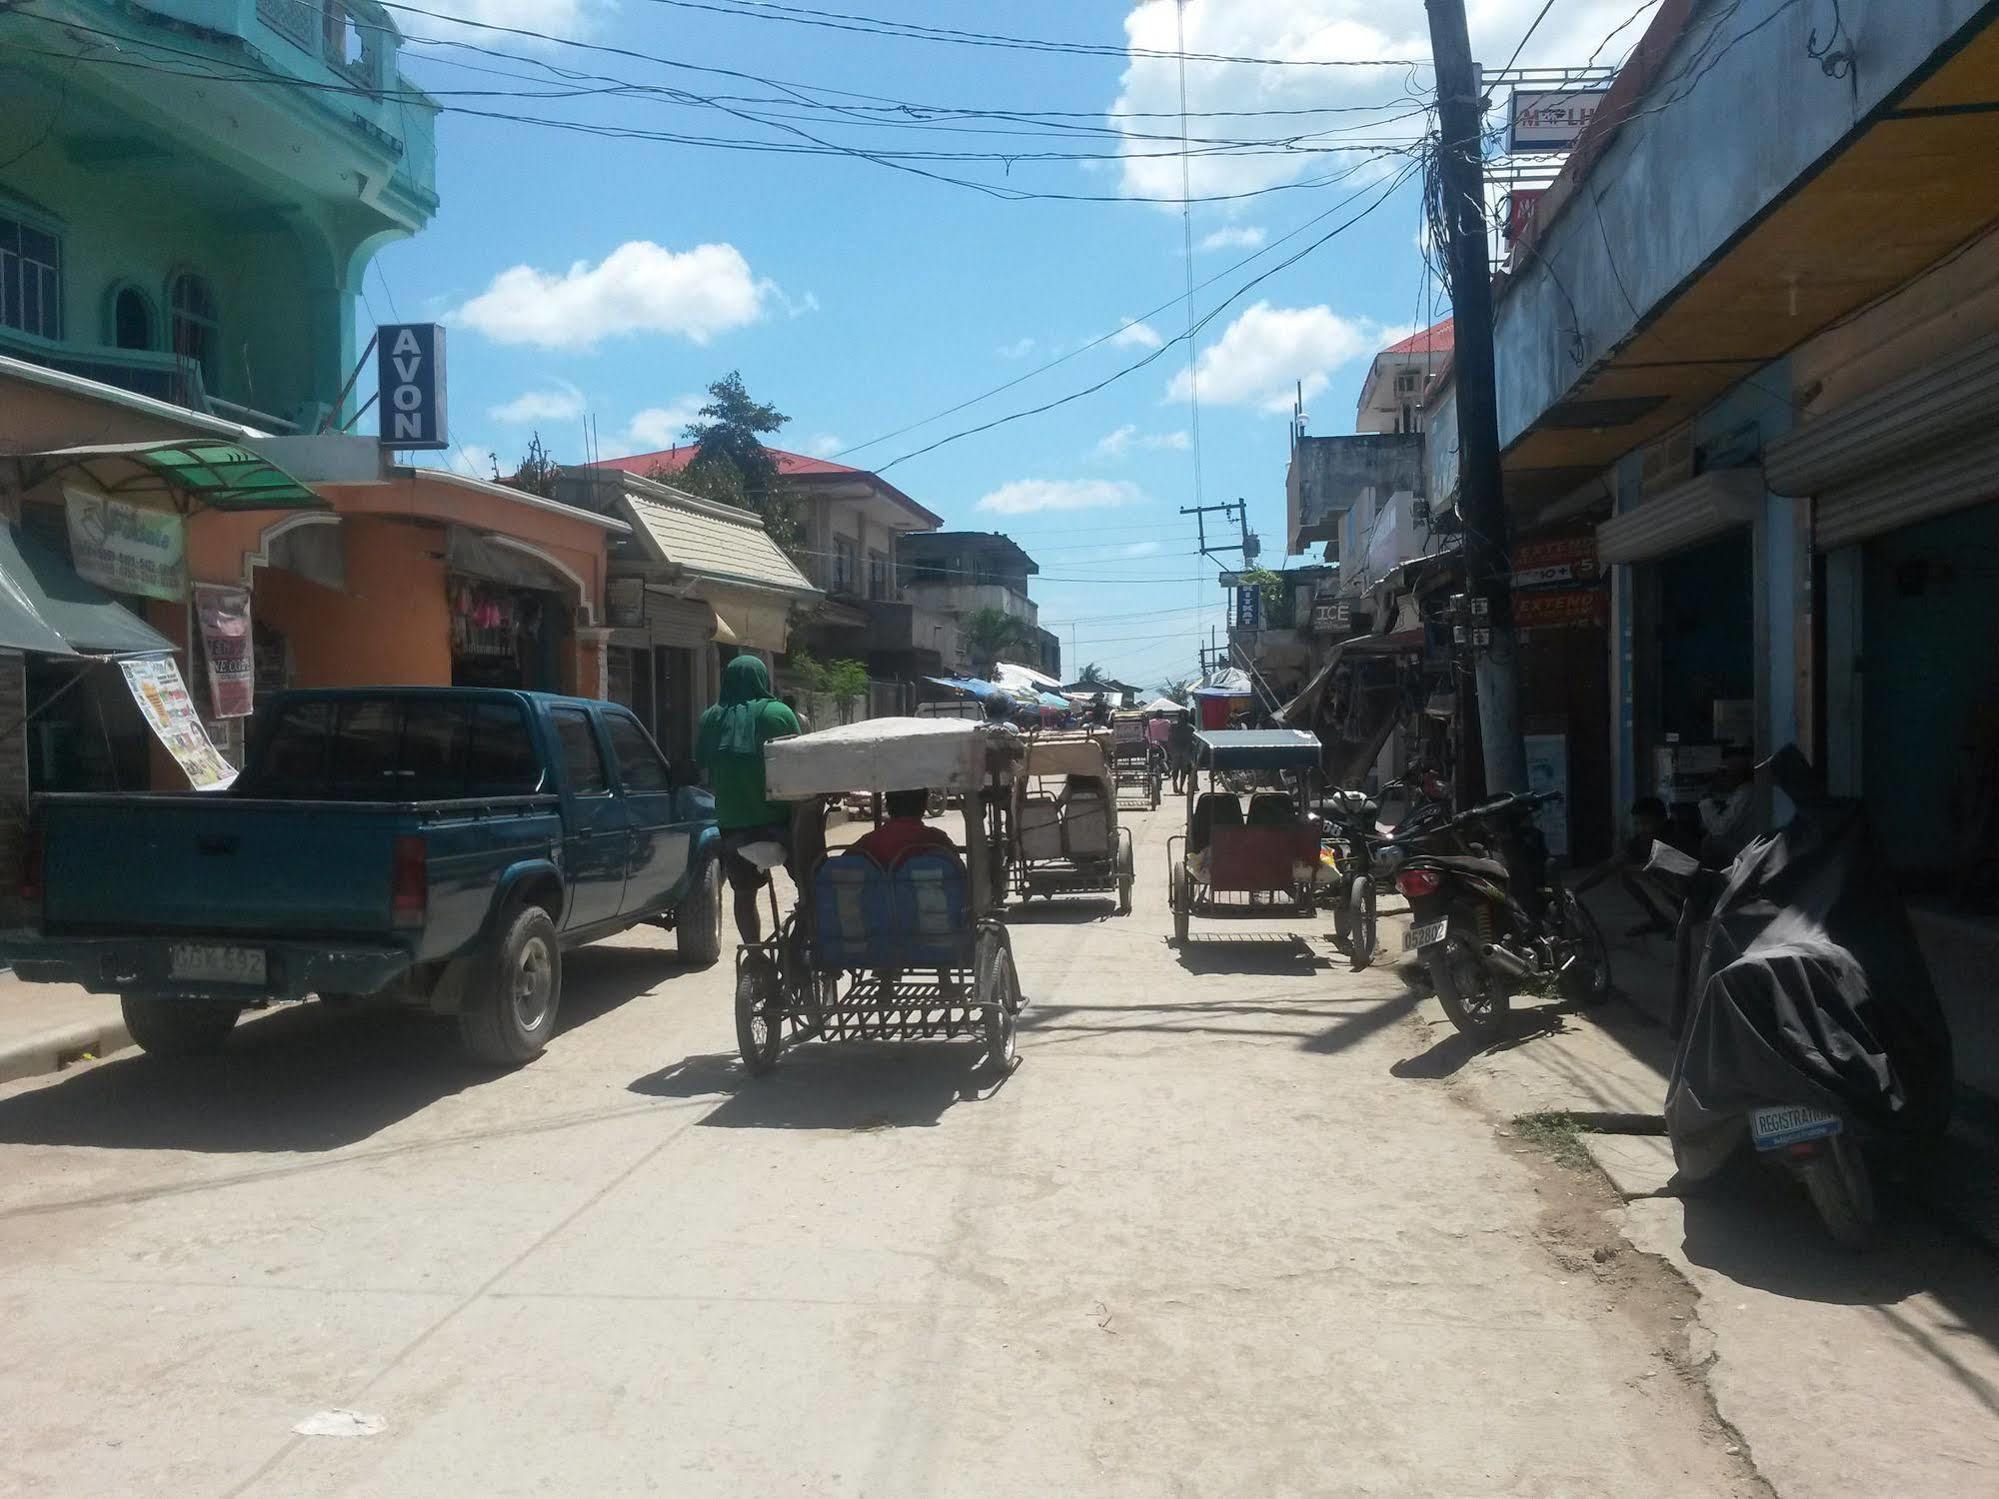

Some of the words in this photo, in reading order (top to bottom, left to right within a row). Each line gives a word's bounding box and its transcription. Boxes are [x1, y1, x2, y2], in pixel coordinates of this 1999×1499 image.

[391, 328, 423, 439] AVON
[1315, 605, 1350, 622] ICE
[1404, 923, 1445, 950] 052802
